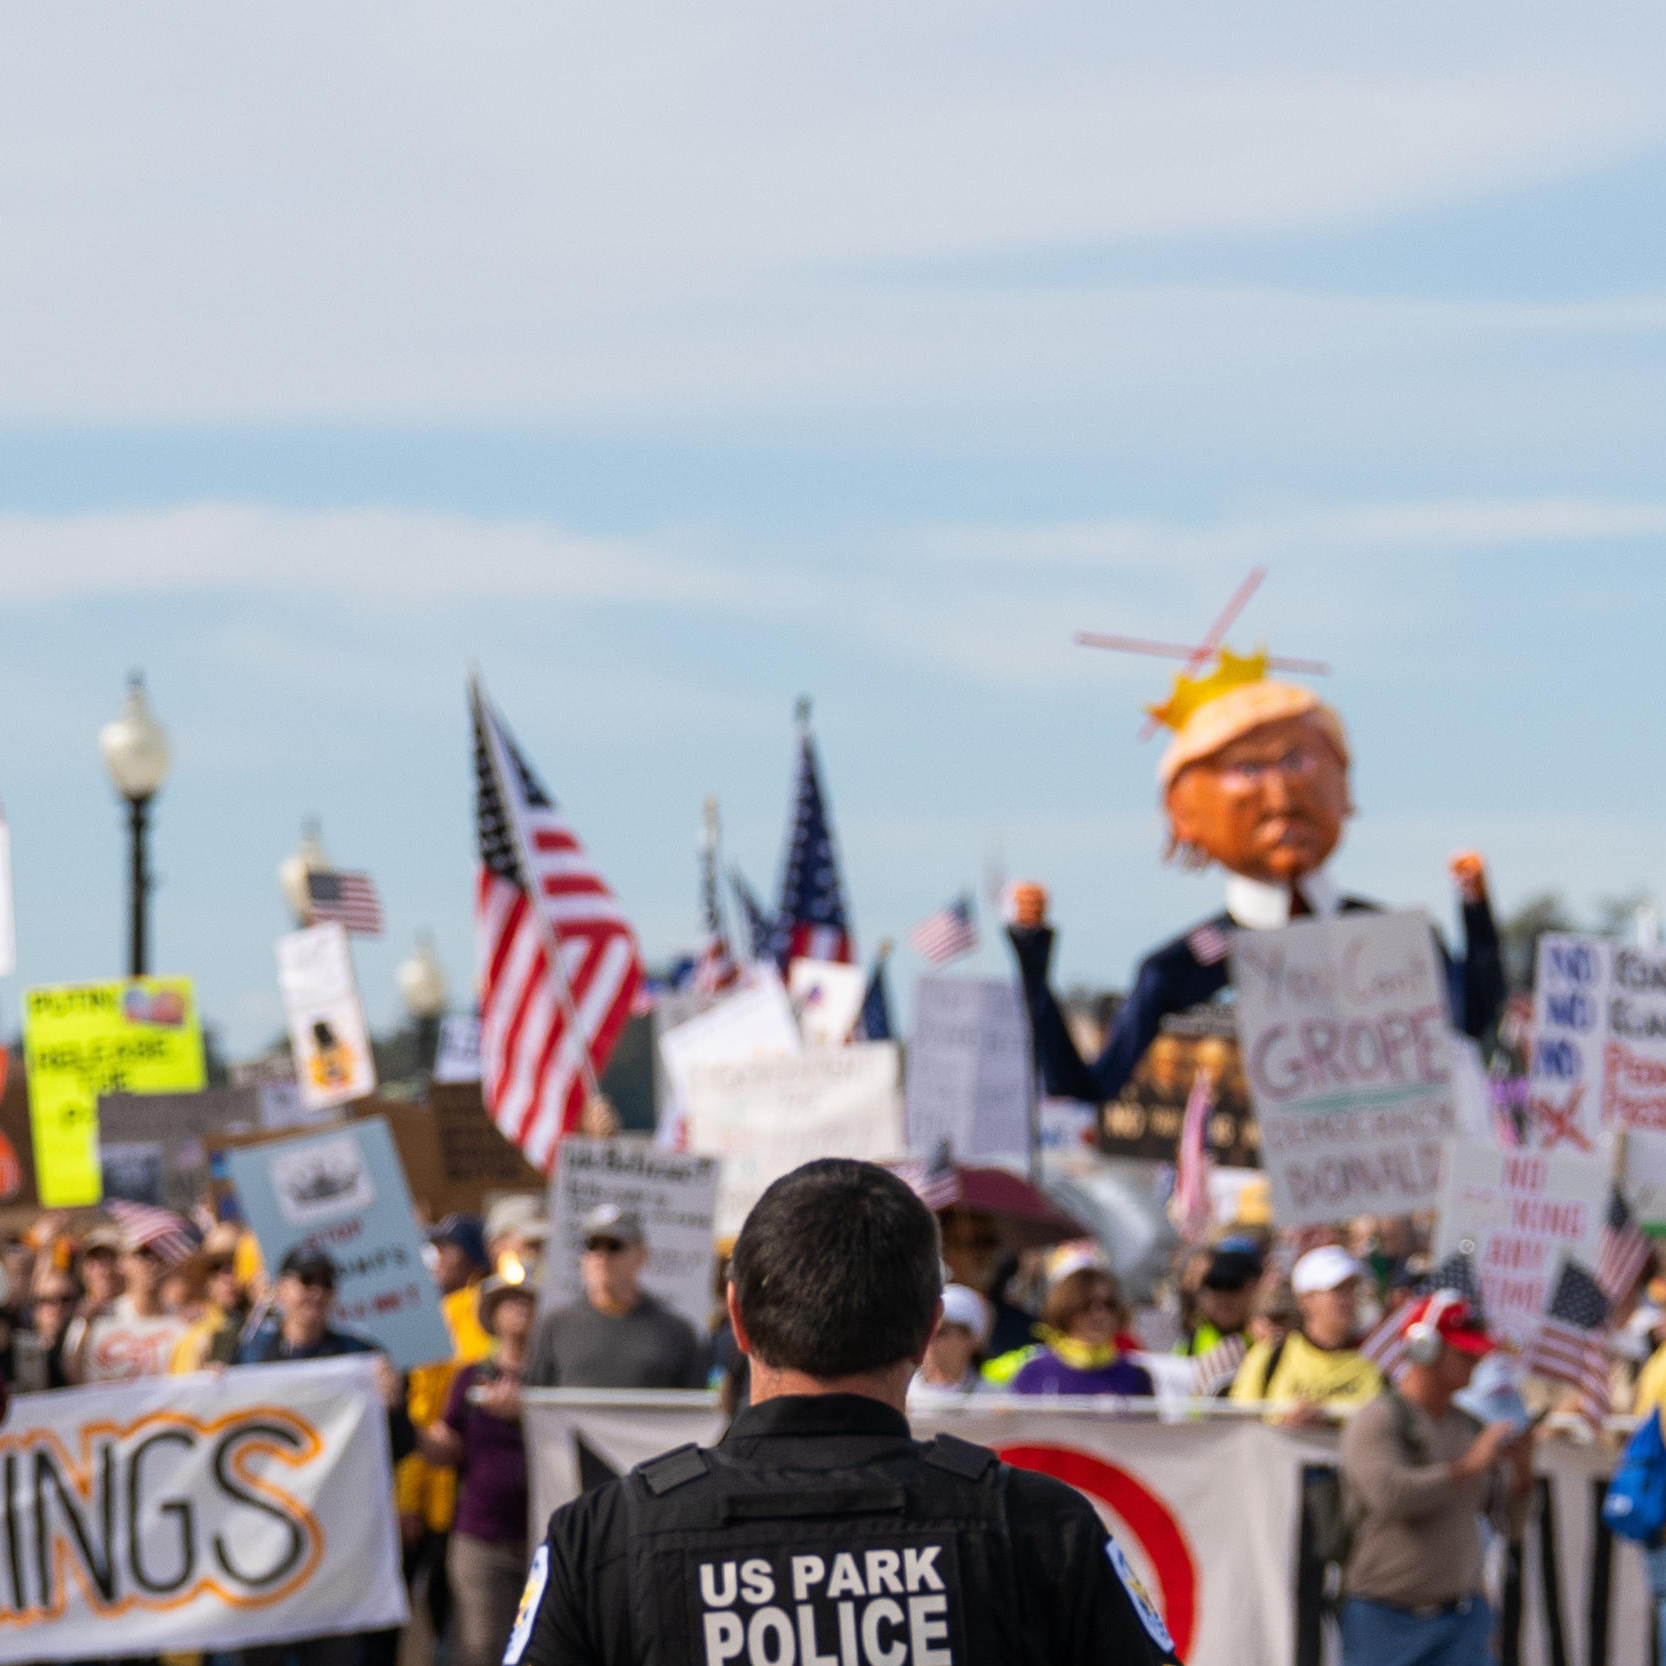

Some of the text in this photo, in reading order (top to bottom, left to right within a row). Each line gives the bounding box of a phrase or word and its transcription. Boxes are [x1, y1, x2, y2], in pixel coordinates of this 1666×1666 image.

[1549, 946, 1600, 984] NO
[1546, 993, 1595, 1033] NO
[1250, 1003, 1452, 1102] GROPE
[1533, 1036, 1582, 1081] NO
[699, 1546, 946, 1607] US PARK
